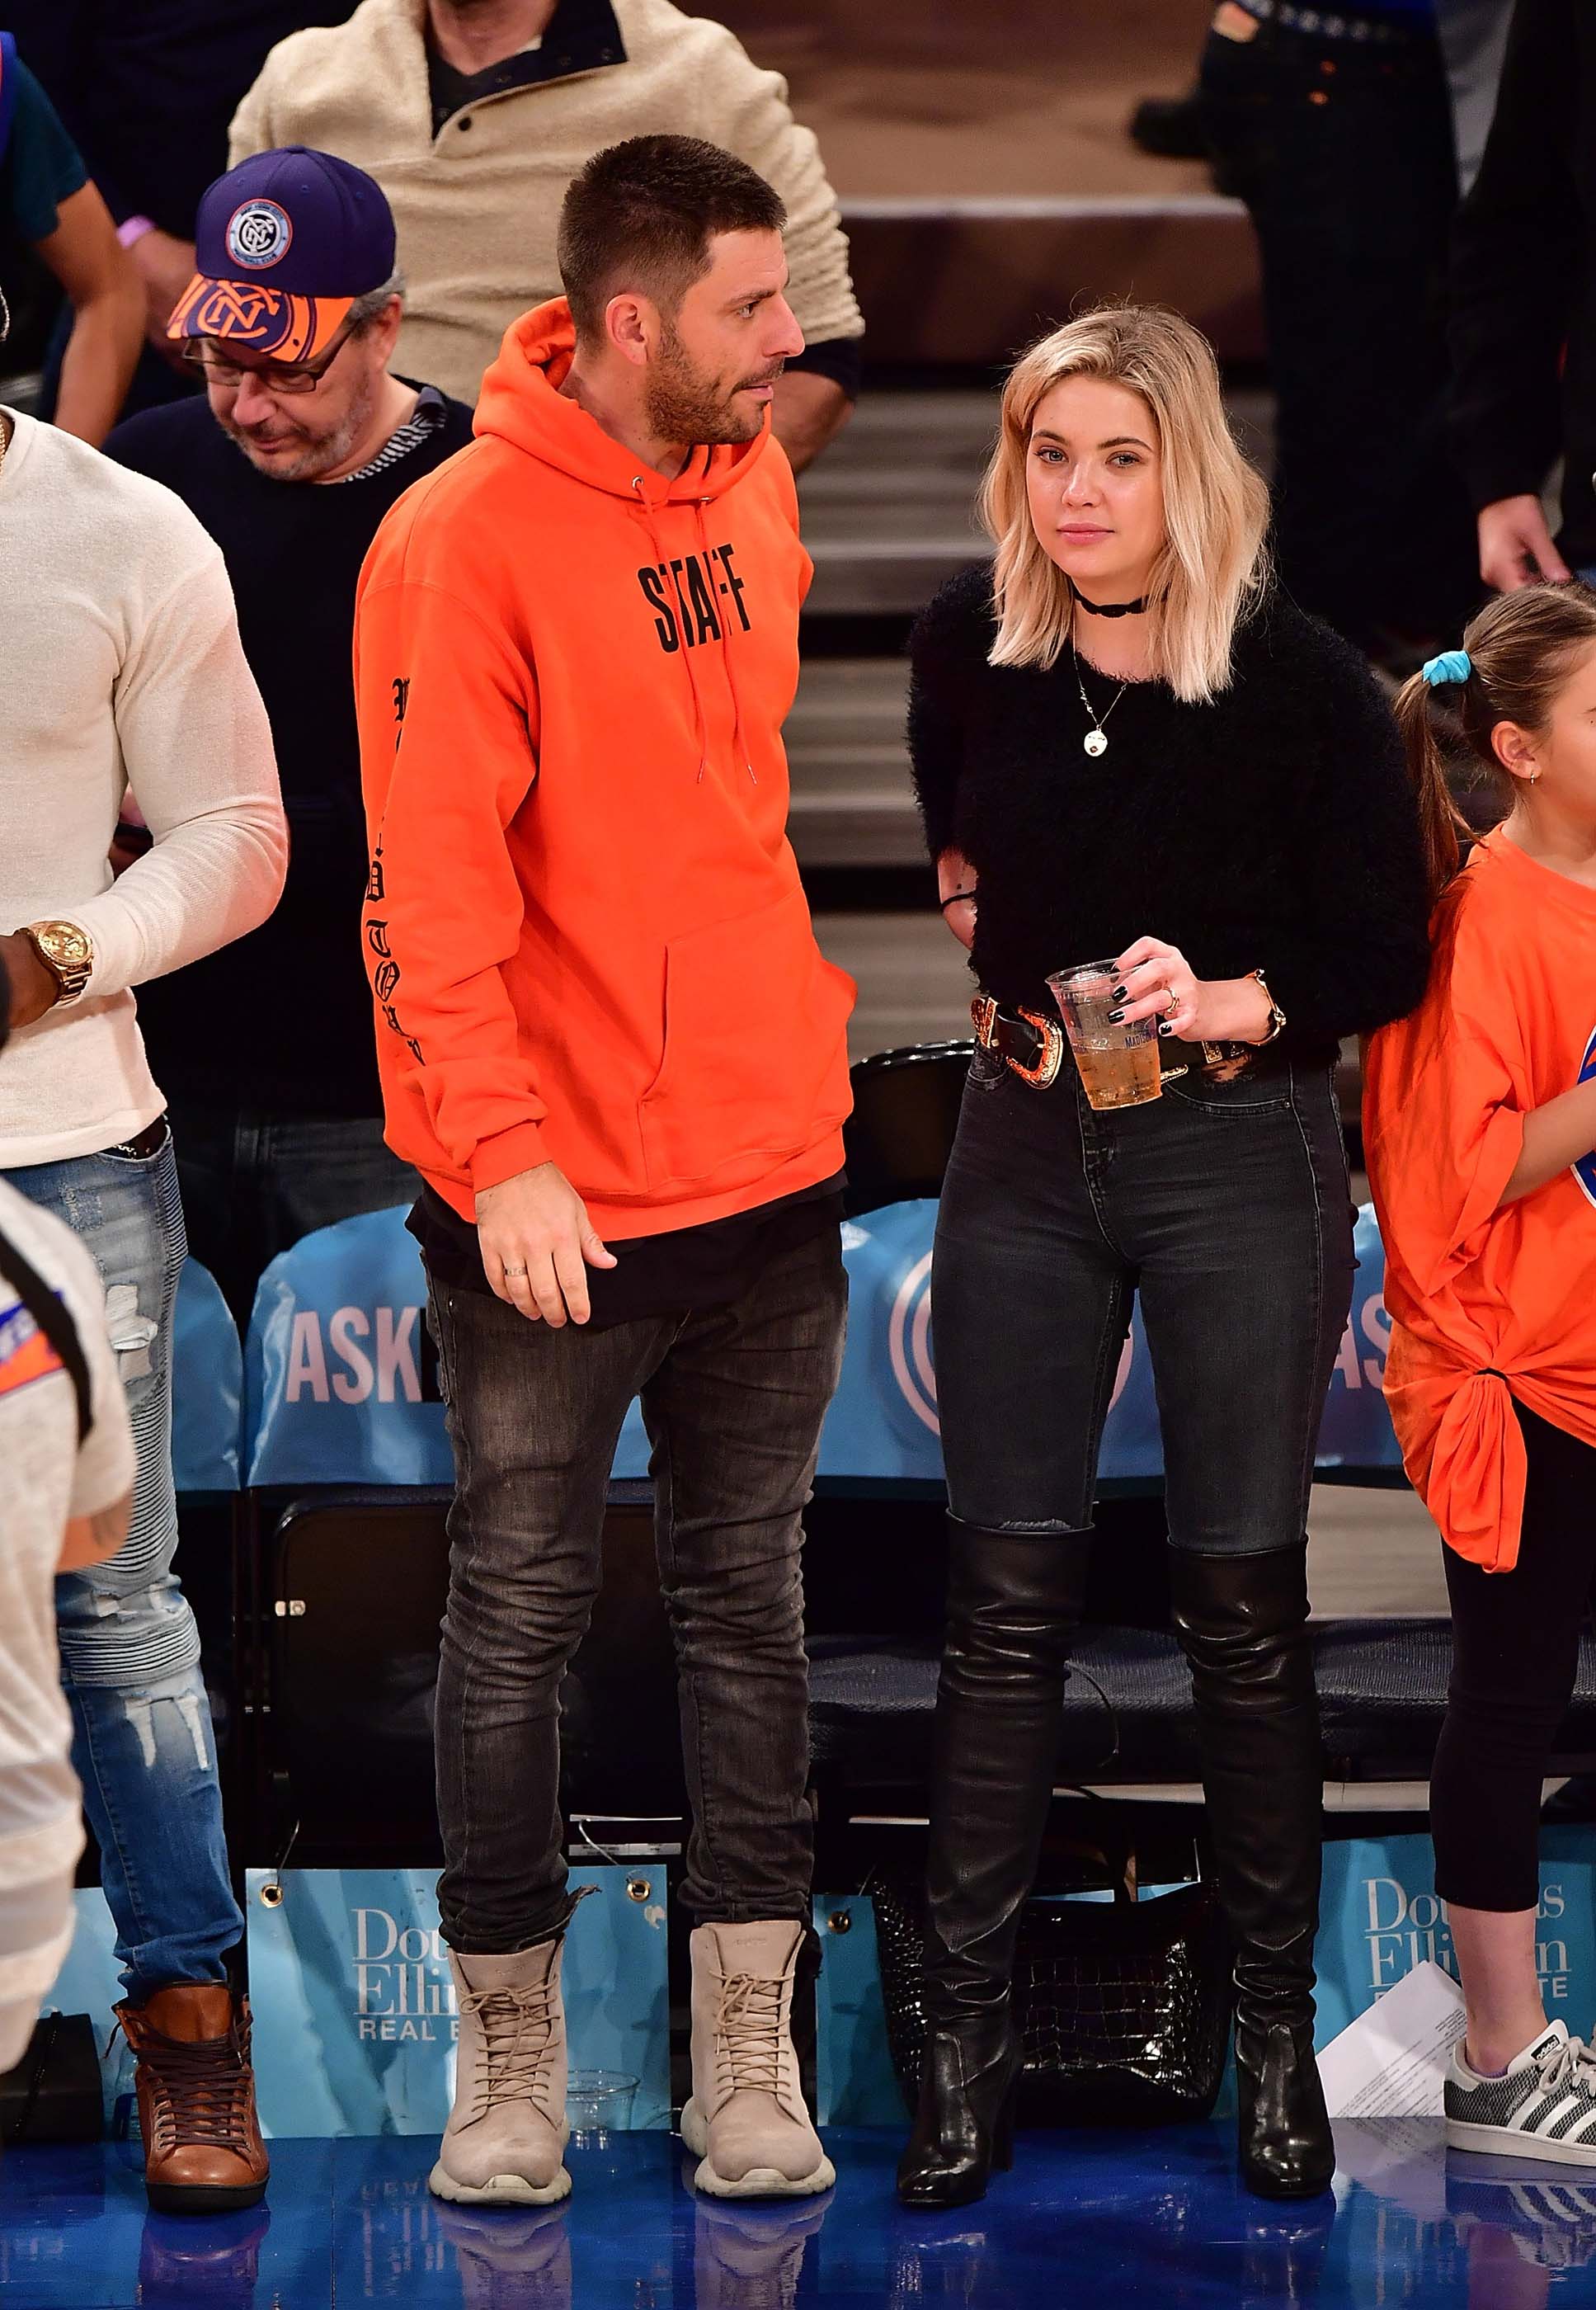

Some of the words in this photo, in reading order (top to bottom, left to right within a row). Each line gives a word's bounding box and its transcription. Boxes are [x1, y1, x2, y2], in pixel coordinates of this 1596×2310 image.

[638, 544, 751, 653] STAFF
[351, 1908, 449, 1961] Dou
[360, 2020, 436, 2041] REAL
